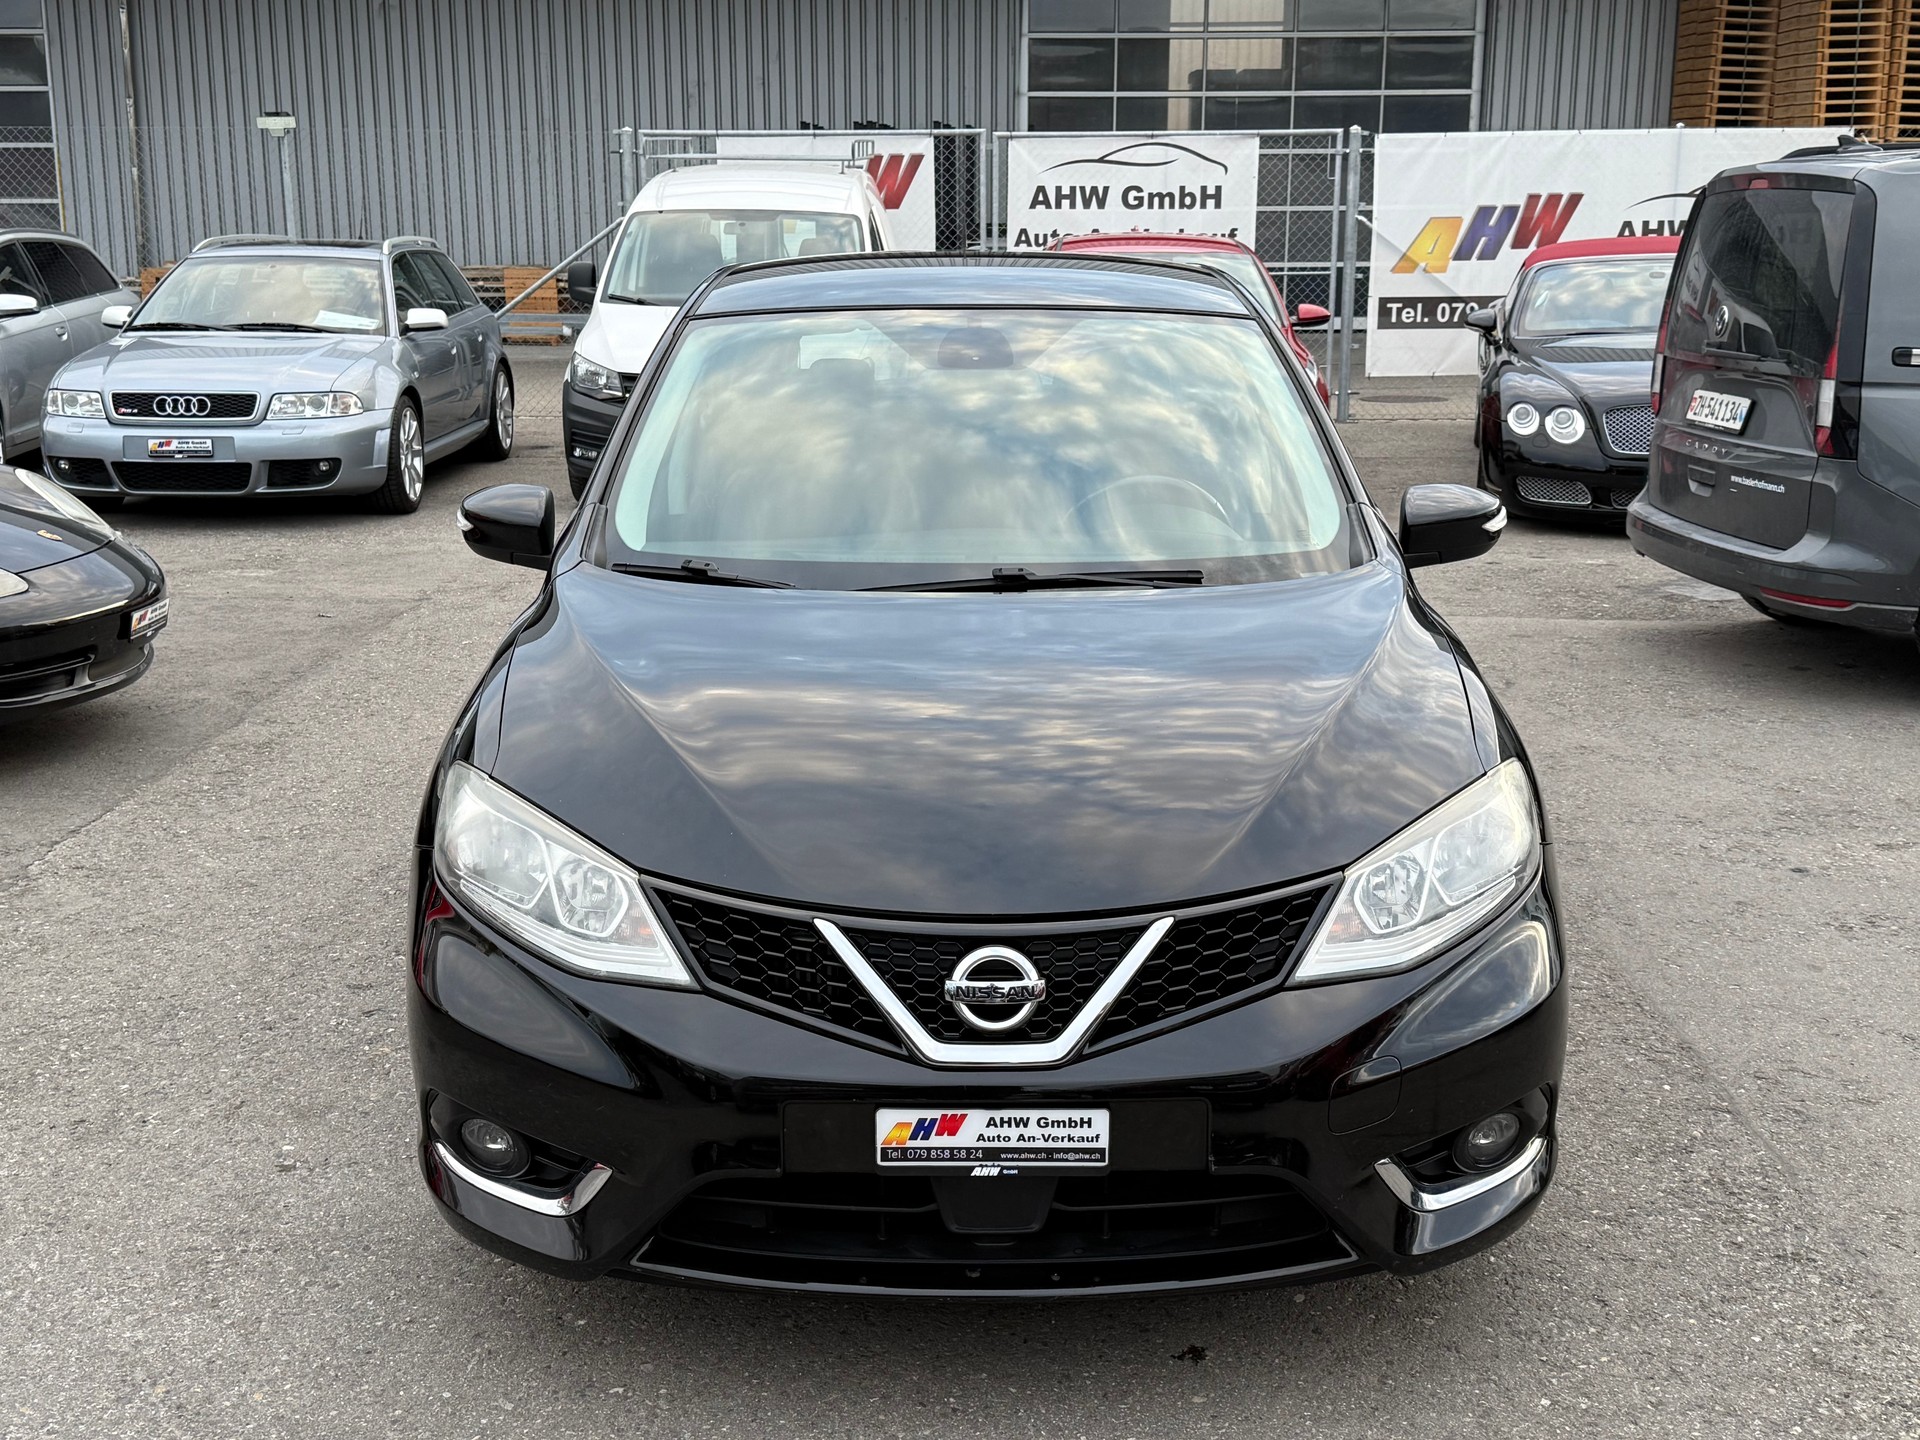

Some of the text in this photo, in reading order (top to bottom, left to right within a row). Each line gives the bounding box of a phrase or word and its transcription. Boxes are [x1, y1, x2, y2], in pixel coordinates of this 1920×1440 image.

[1028, 185, 1222, 210] AHW GmbH
[1390, 192, 1585, 274] AHW
[1386, 303, 1429, 323] Tel.
[1685, 439, 1728, 455] CADDY
[955, 985, 1035, 999] NISSAN
[880, 1113, 968, 1146] AHW
[985, 1116, 1093, 1129] AHW GmbH
[976, 1133, 1101, 1143] Auto An-Verkauf
[887, 1149, 984, 1159] Tel. 079 858 58 24
[1000, 1151, 1047, 1160] www.ahw.ch
[1053, 1151, 1101, 1161] info@ahw.ch
[970, 1166, 1001, 1177] AHW
